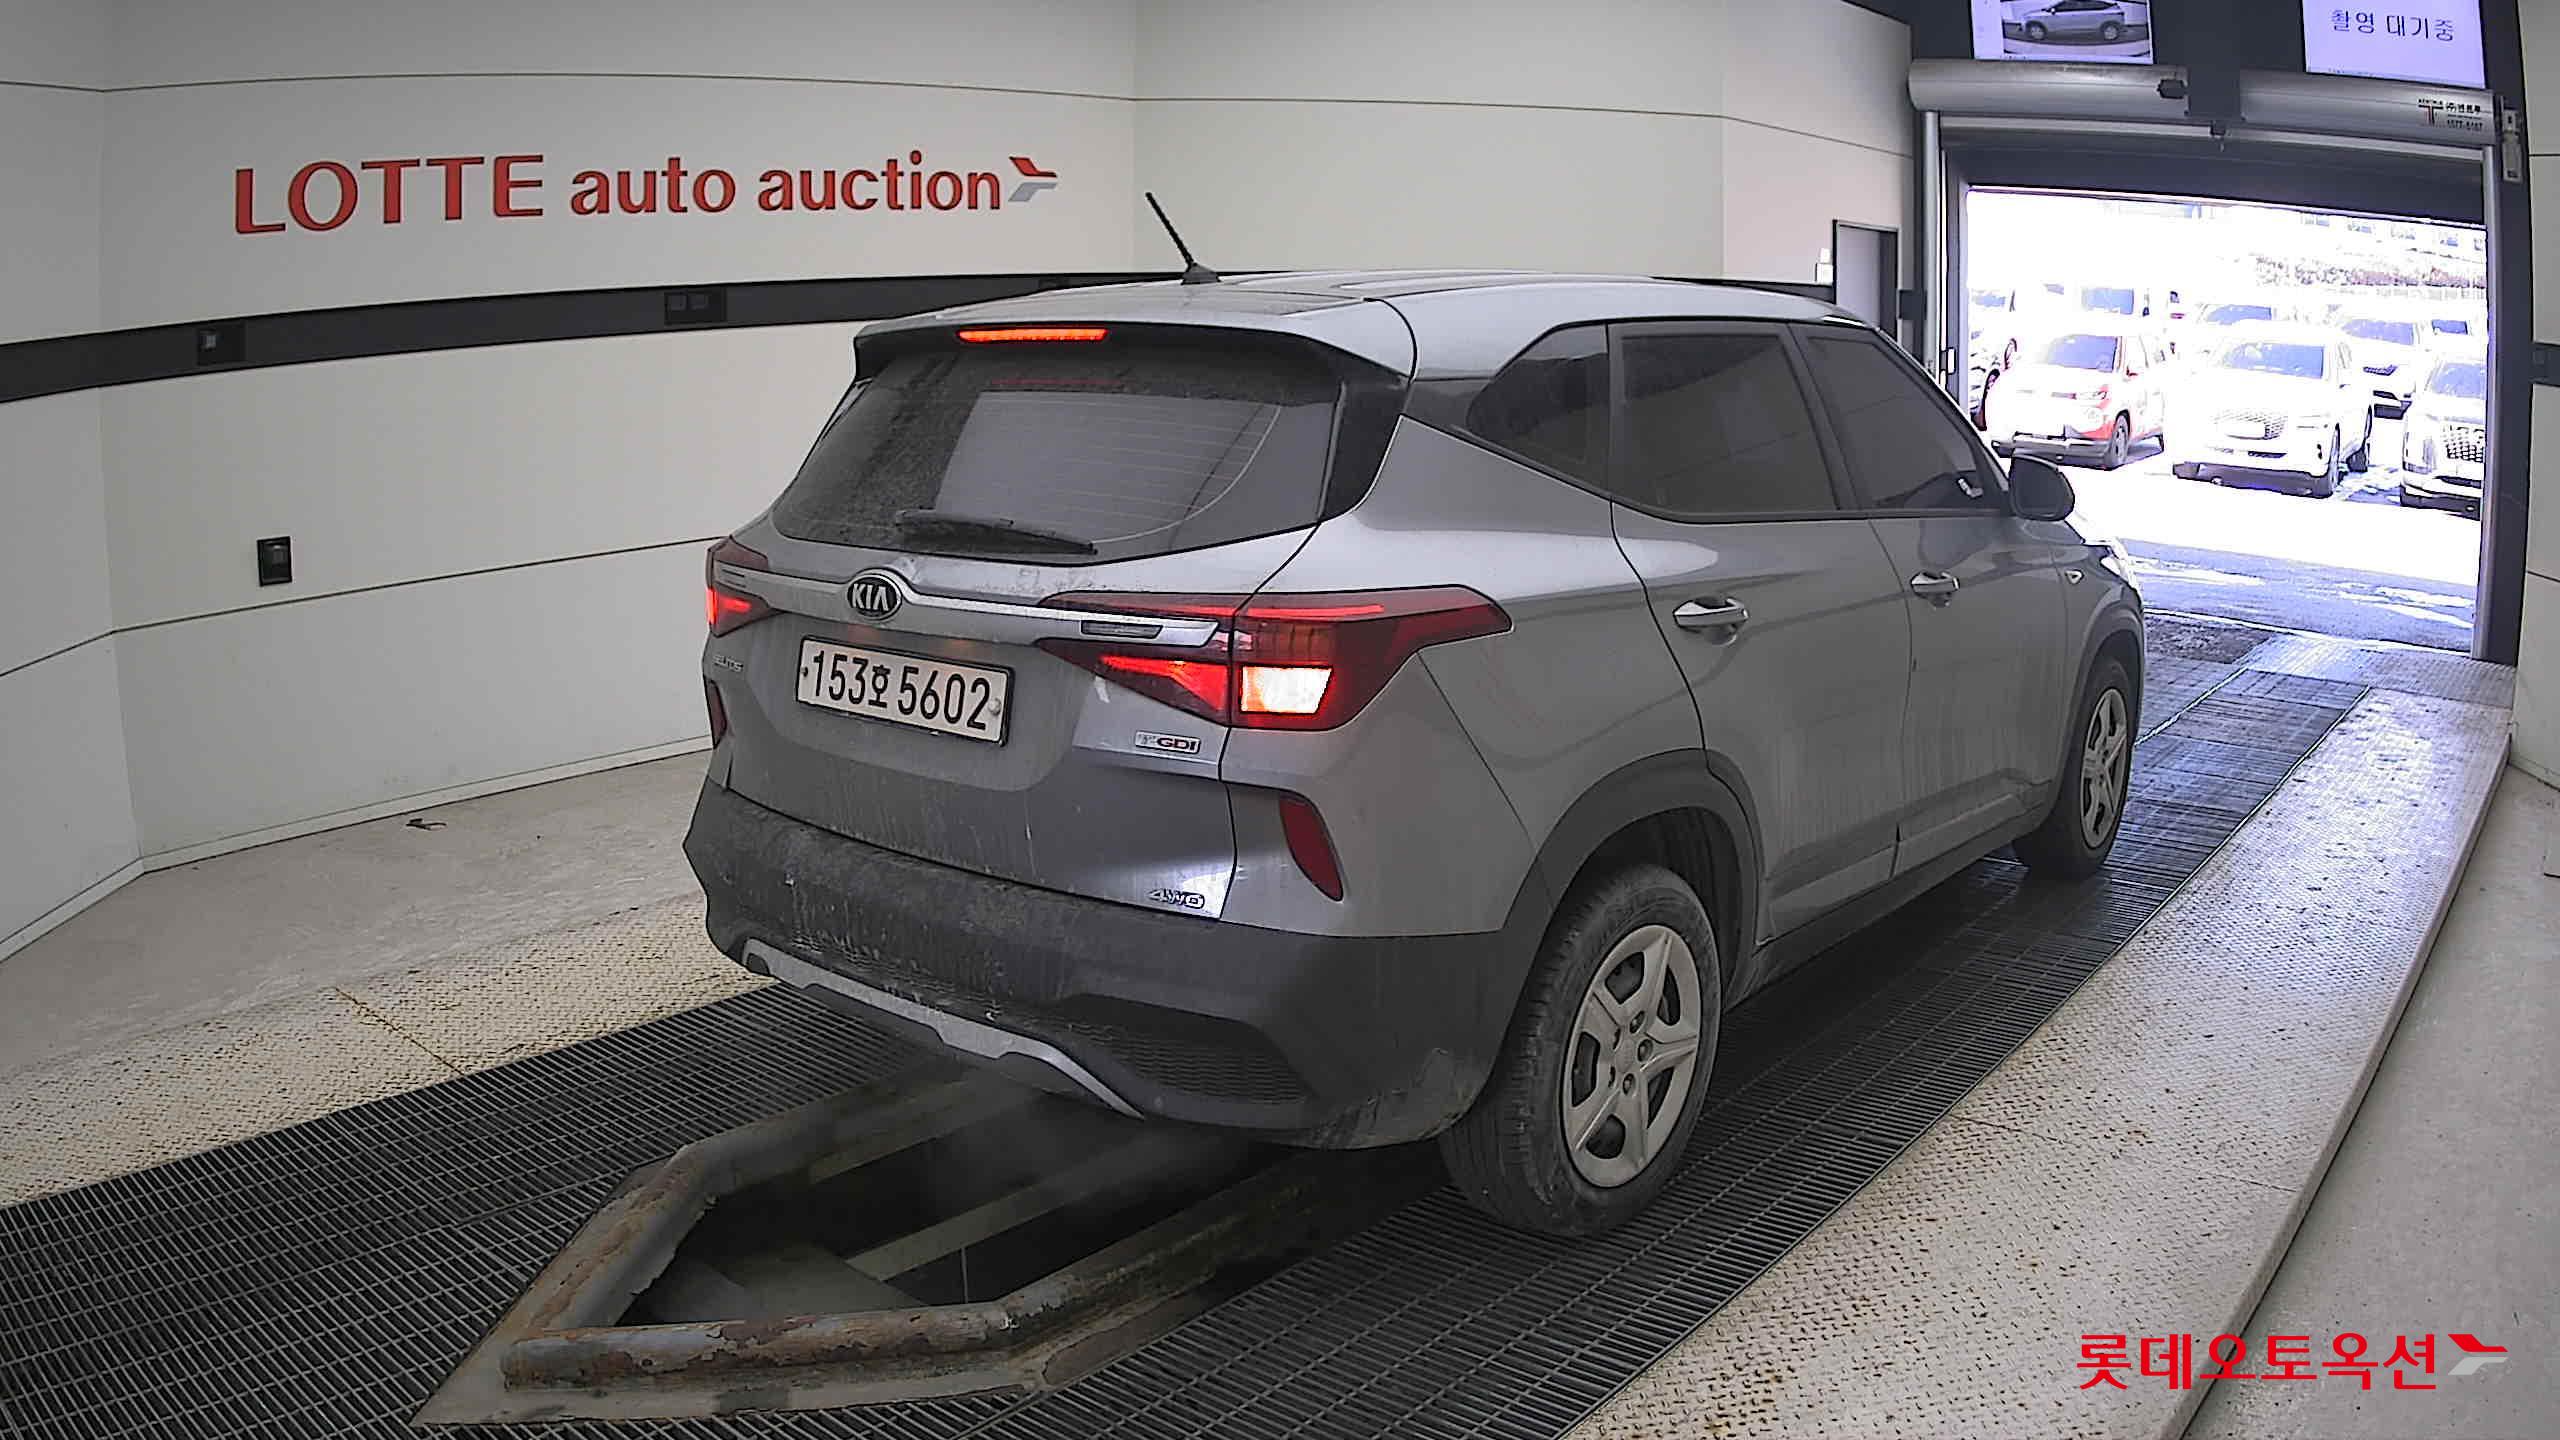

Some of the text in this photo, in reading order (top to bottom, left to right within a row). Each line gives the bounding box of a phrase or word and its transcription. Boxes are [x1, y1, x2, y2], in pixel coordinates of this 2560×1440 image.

[2331, 9, 2454, 42] 촬영 대기중
[236, 151, 1002, 234] LOTTE auto auction
[852, 583, 889, 611] KIA
[813, 650, 991, 731] 153호 5602
[1147, 888, 1206, 910] 4WD
